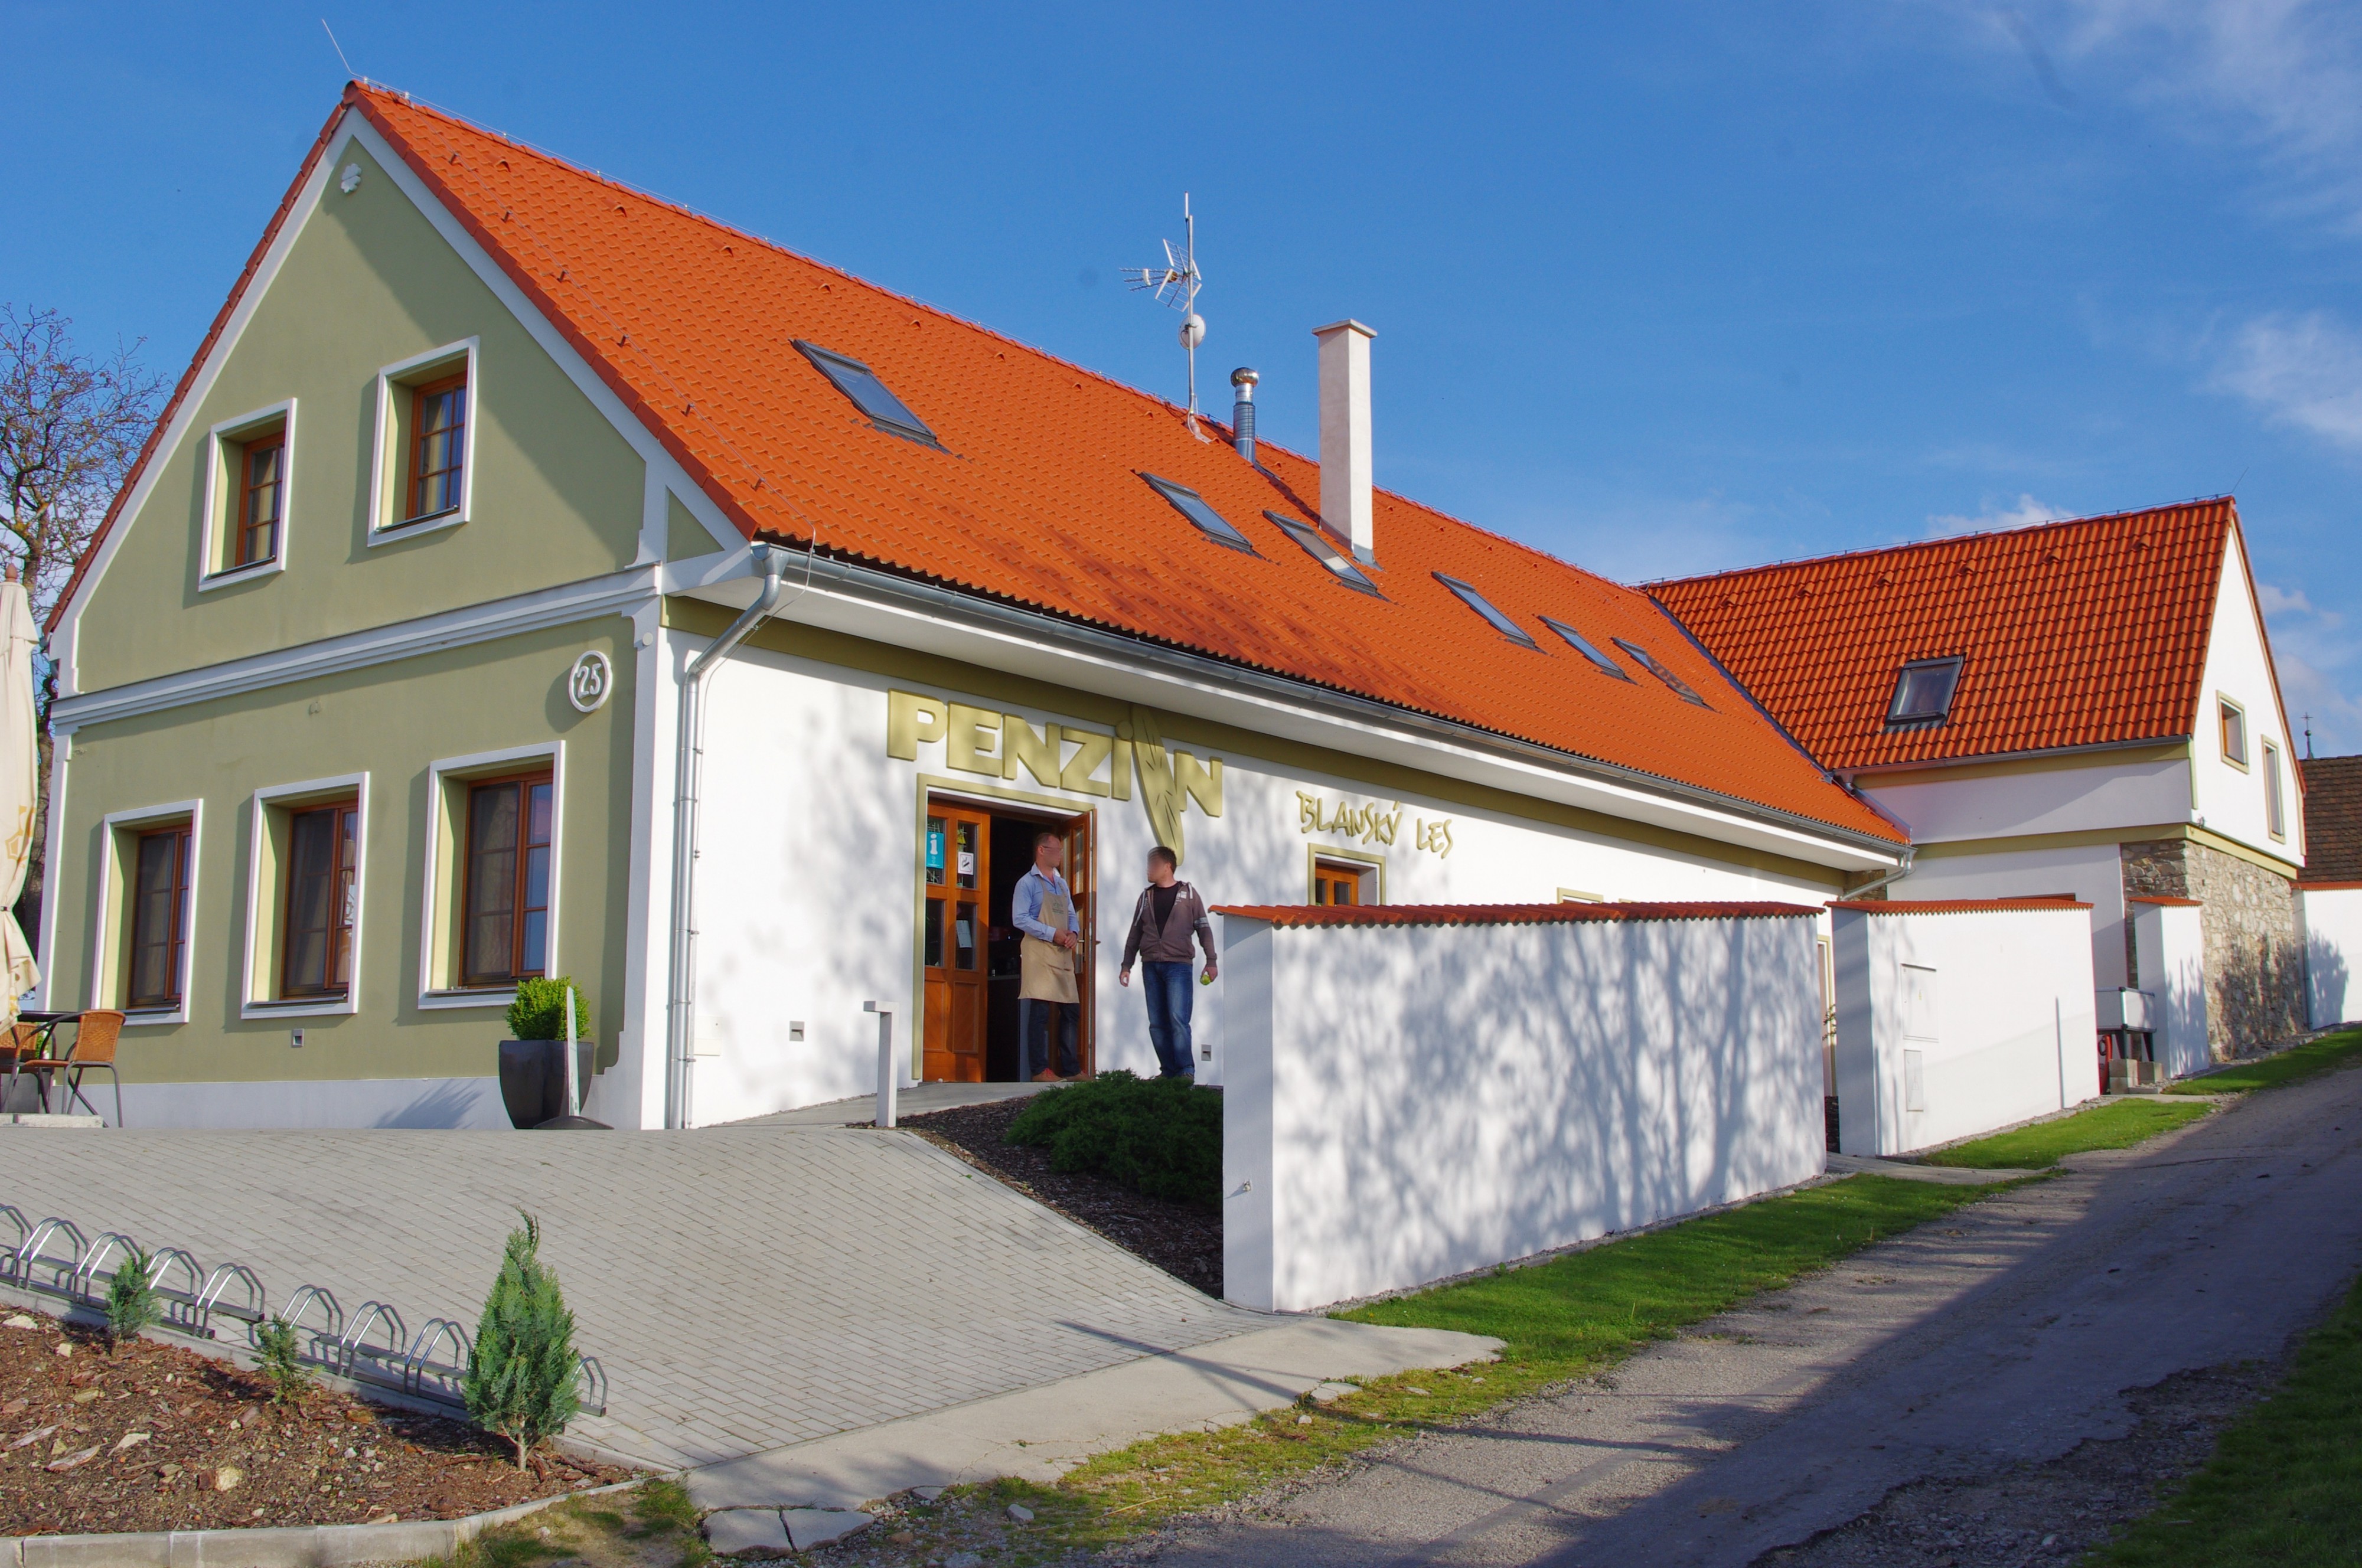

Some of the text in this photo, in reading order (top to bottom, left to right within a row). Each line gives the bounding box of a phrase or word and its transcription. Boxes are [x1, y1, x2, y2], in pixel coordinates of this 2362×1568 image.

[577, 663, 602, 699] 25
[1296, 790, 1454, 860] BLANSKÝ LES
[930, 834, 938, 855] i
